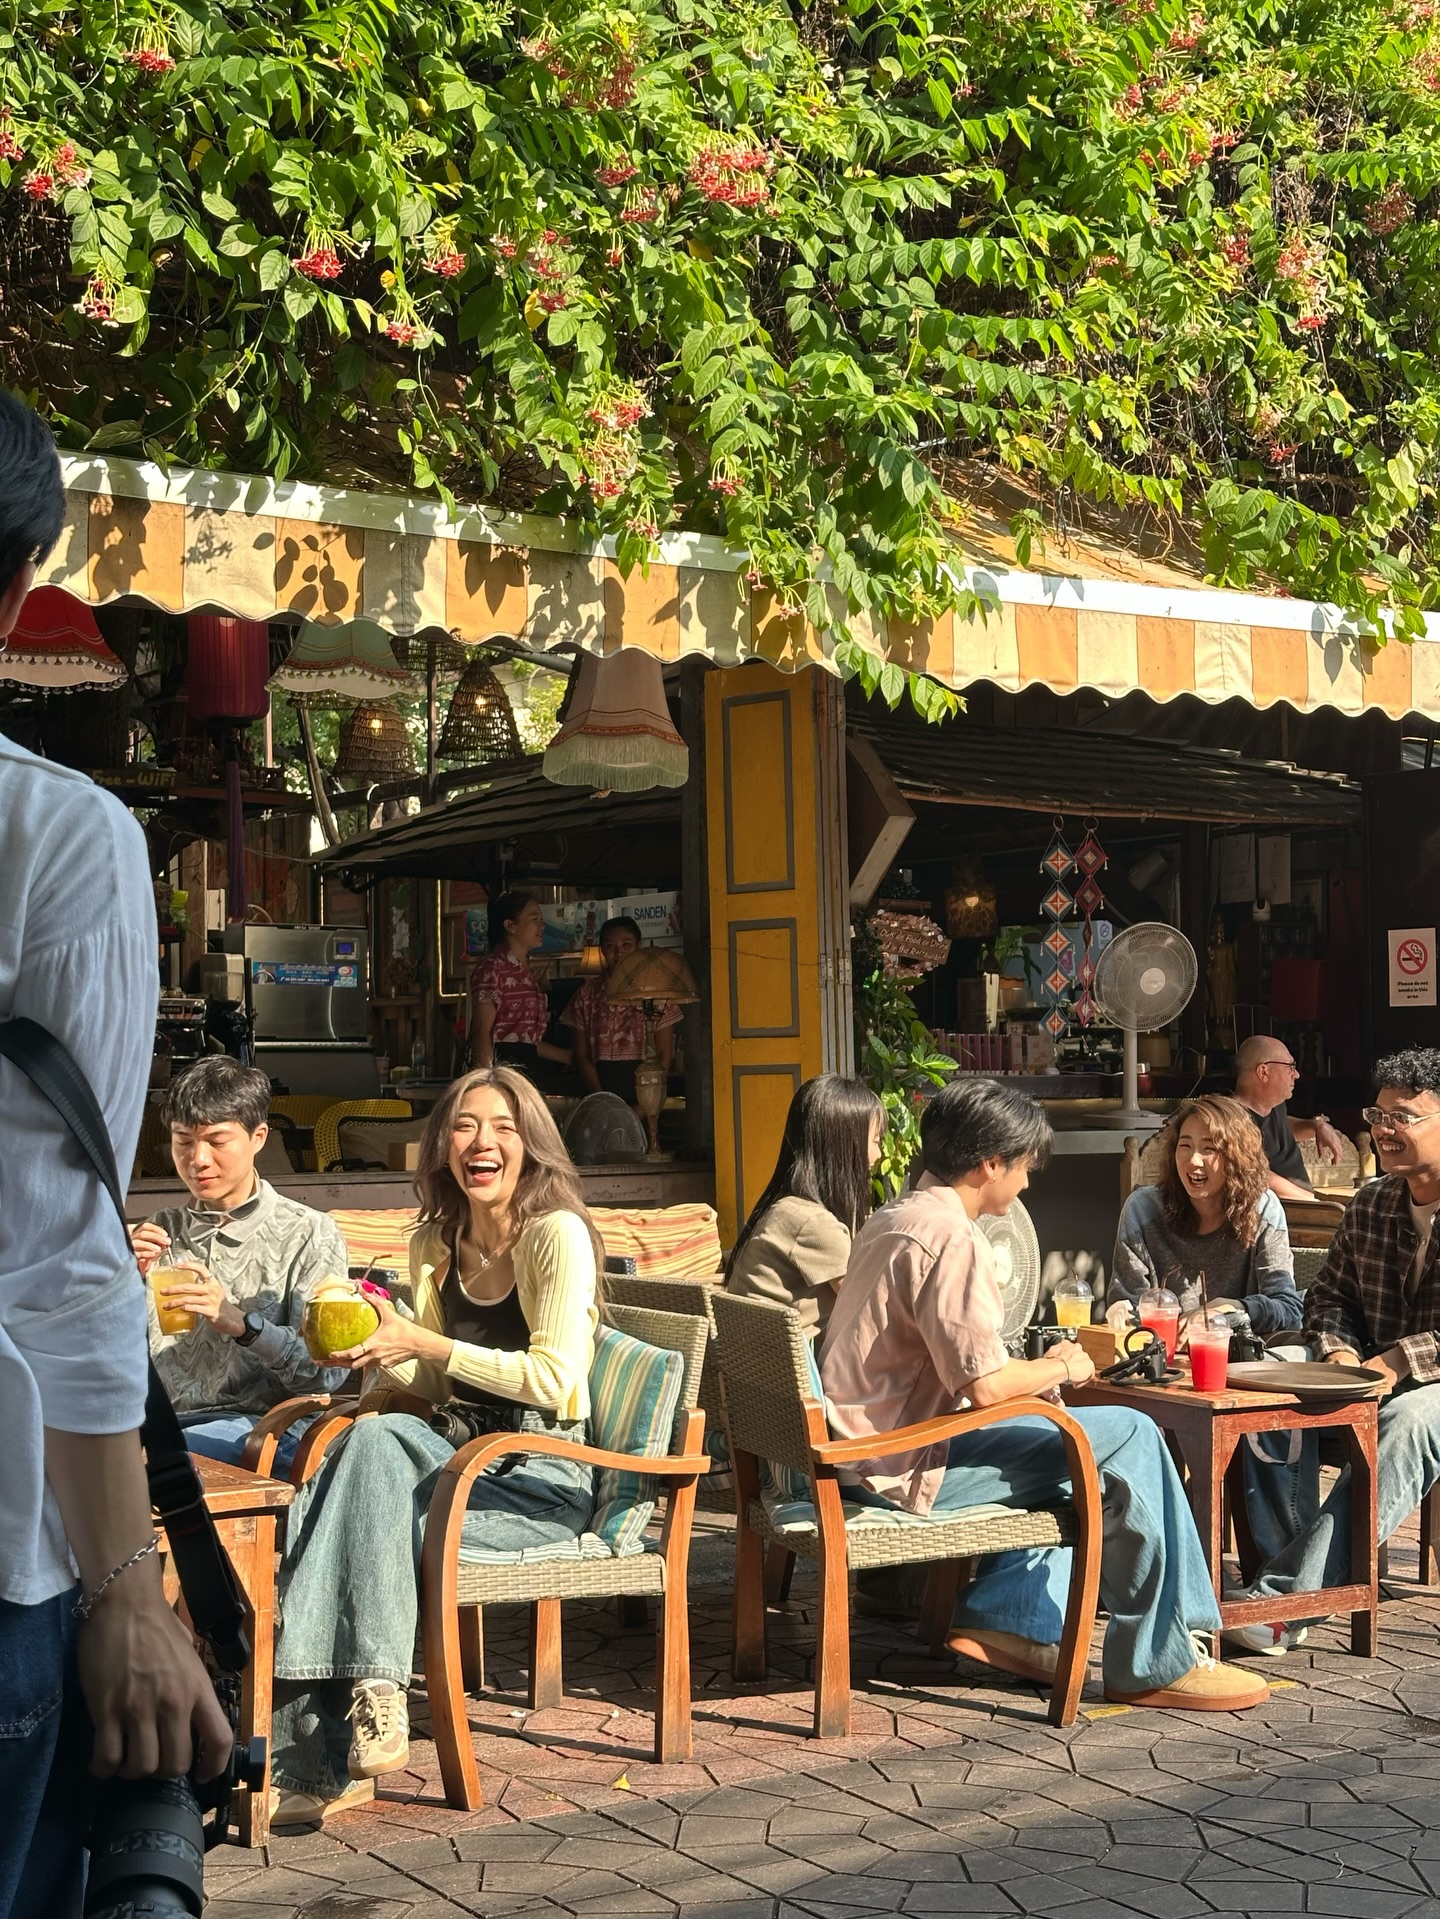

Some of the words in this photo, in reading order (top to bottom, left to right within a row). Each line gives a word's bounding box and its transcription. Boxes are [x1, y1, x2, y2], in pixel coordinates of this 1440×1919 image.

[92, 769, 121, 786] Free
[633, 904, 667, 920] SANDEN
[905, 934, 922, 945] Food
